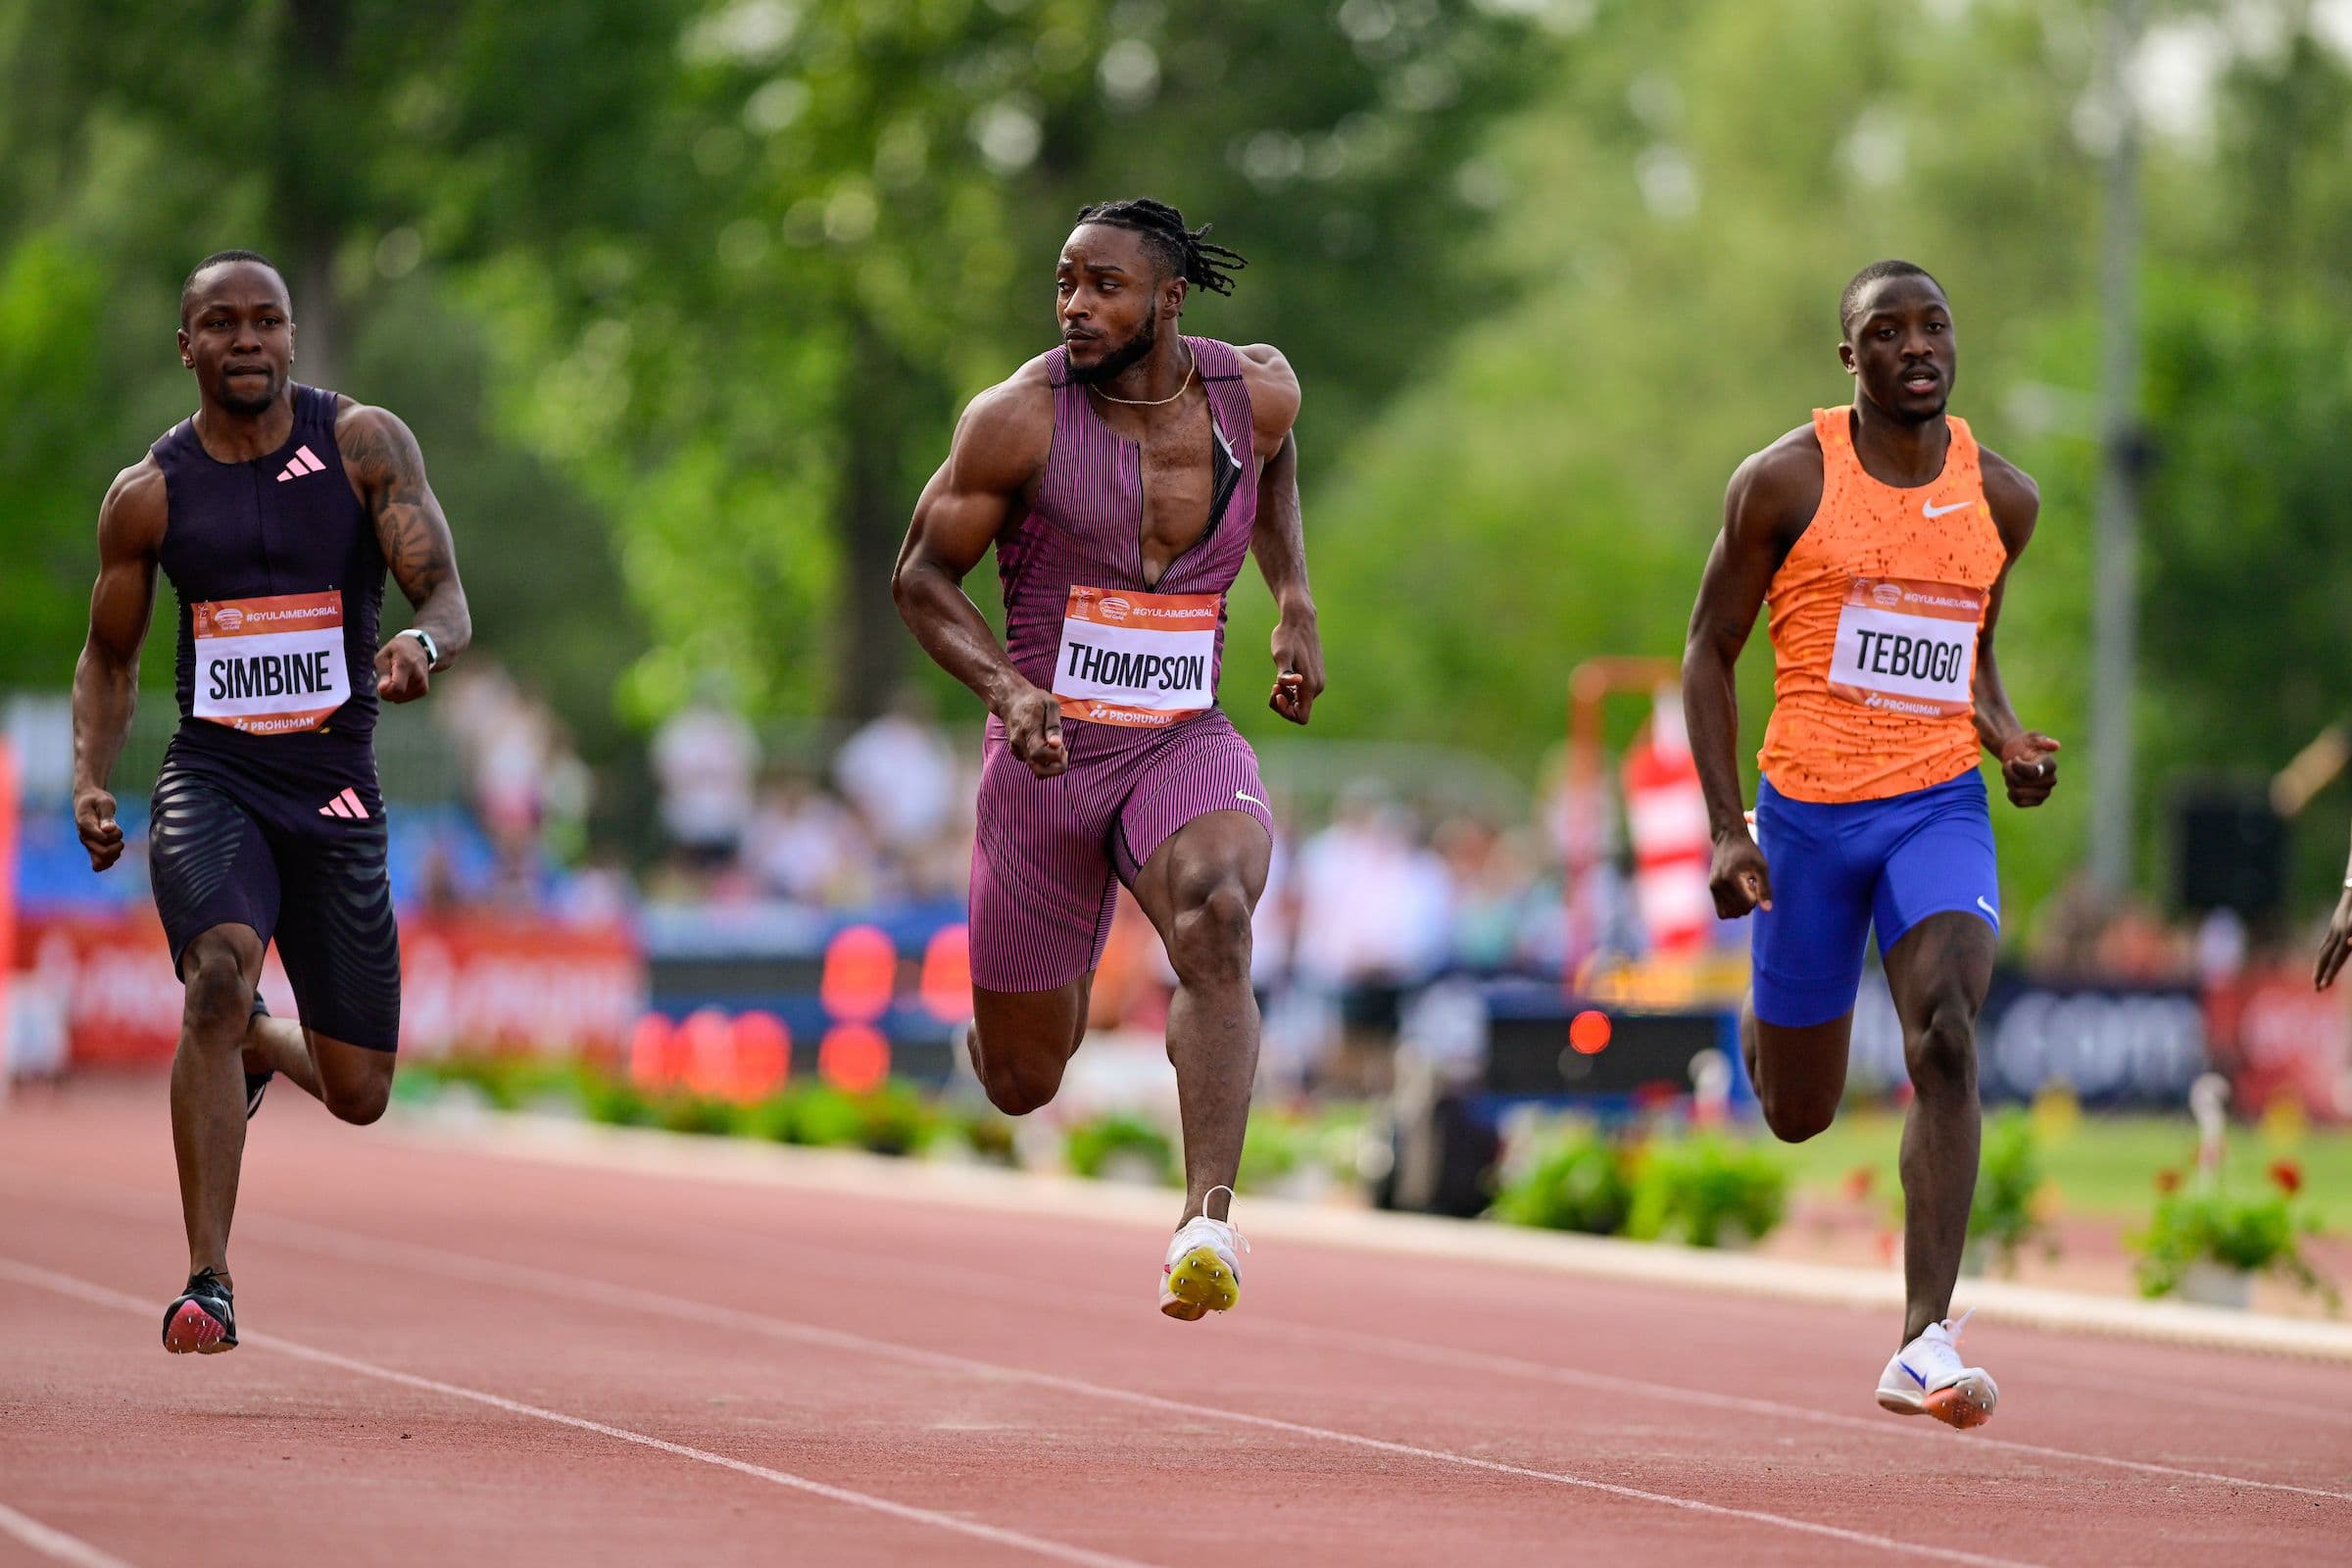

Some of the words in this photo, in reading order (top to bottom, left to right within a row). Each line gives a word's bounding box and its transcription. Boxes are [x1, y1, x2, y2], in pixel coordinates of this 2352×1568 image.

[246, 607, 338, 622] #GYULAIMEMORIAL
[1132, 607, 1214, 618] #GYULAIMEMORIAL
[1857, 629, 1963, 683] TEBOGO
[1067, 642, 1204, 690] THOMPSON
[210, 651, 332, 700] SIMBINE
[1883, 699, 1941, 715] PROHUMAN
[251, 716, 315, 731] PROHUMAN
[1108, 710, 1173, 724] PROHUMAN
